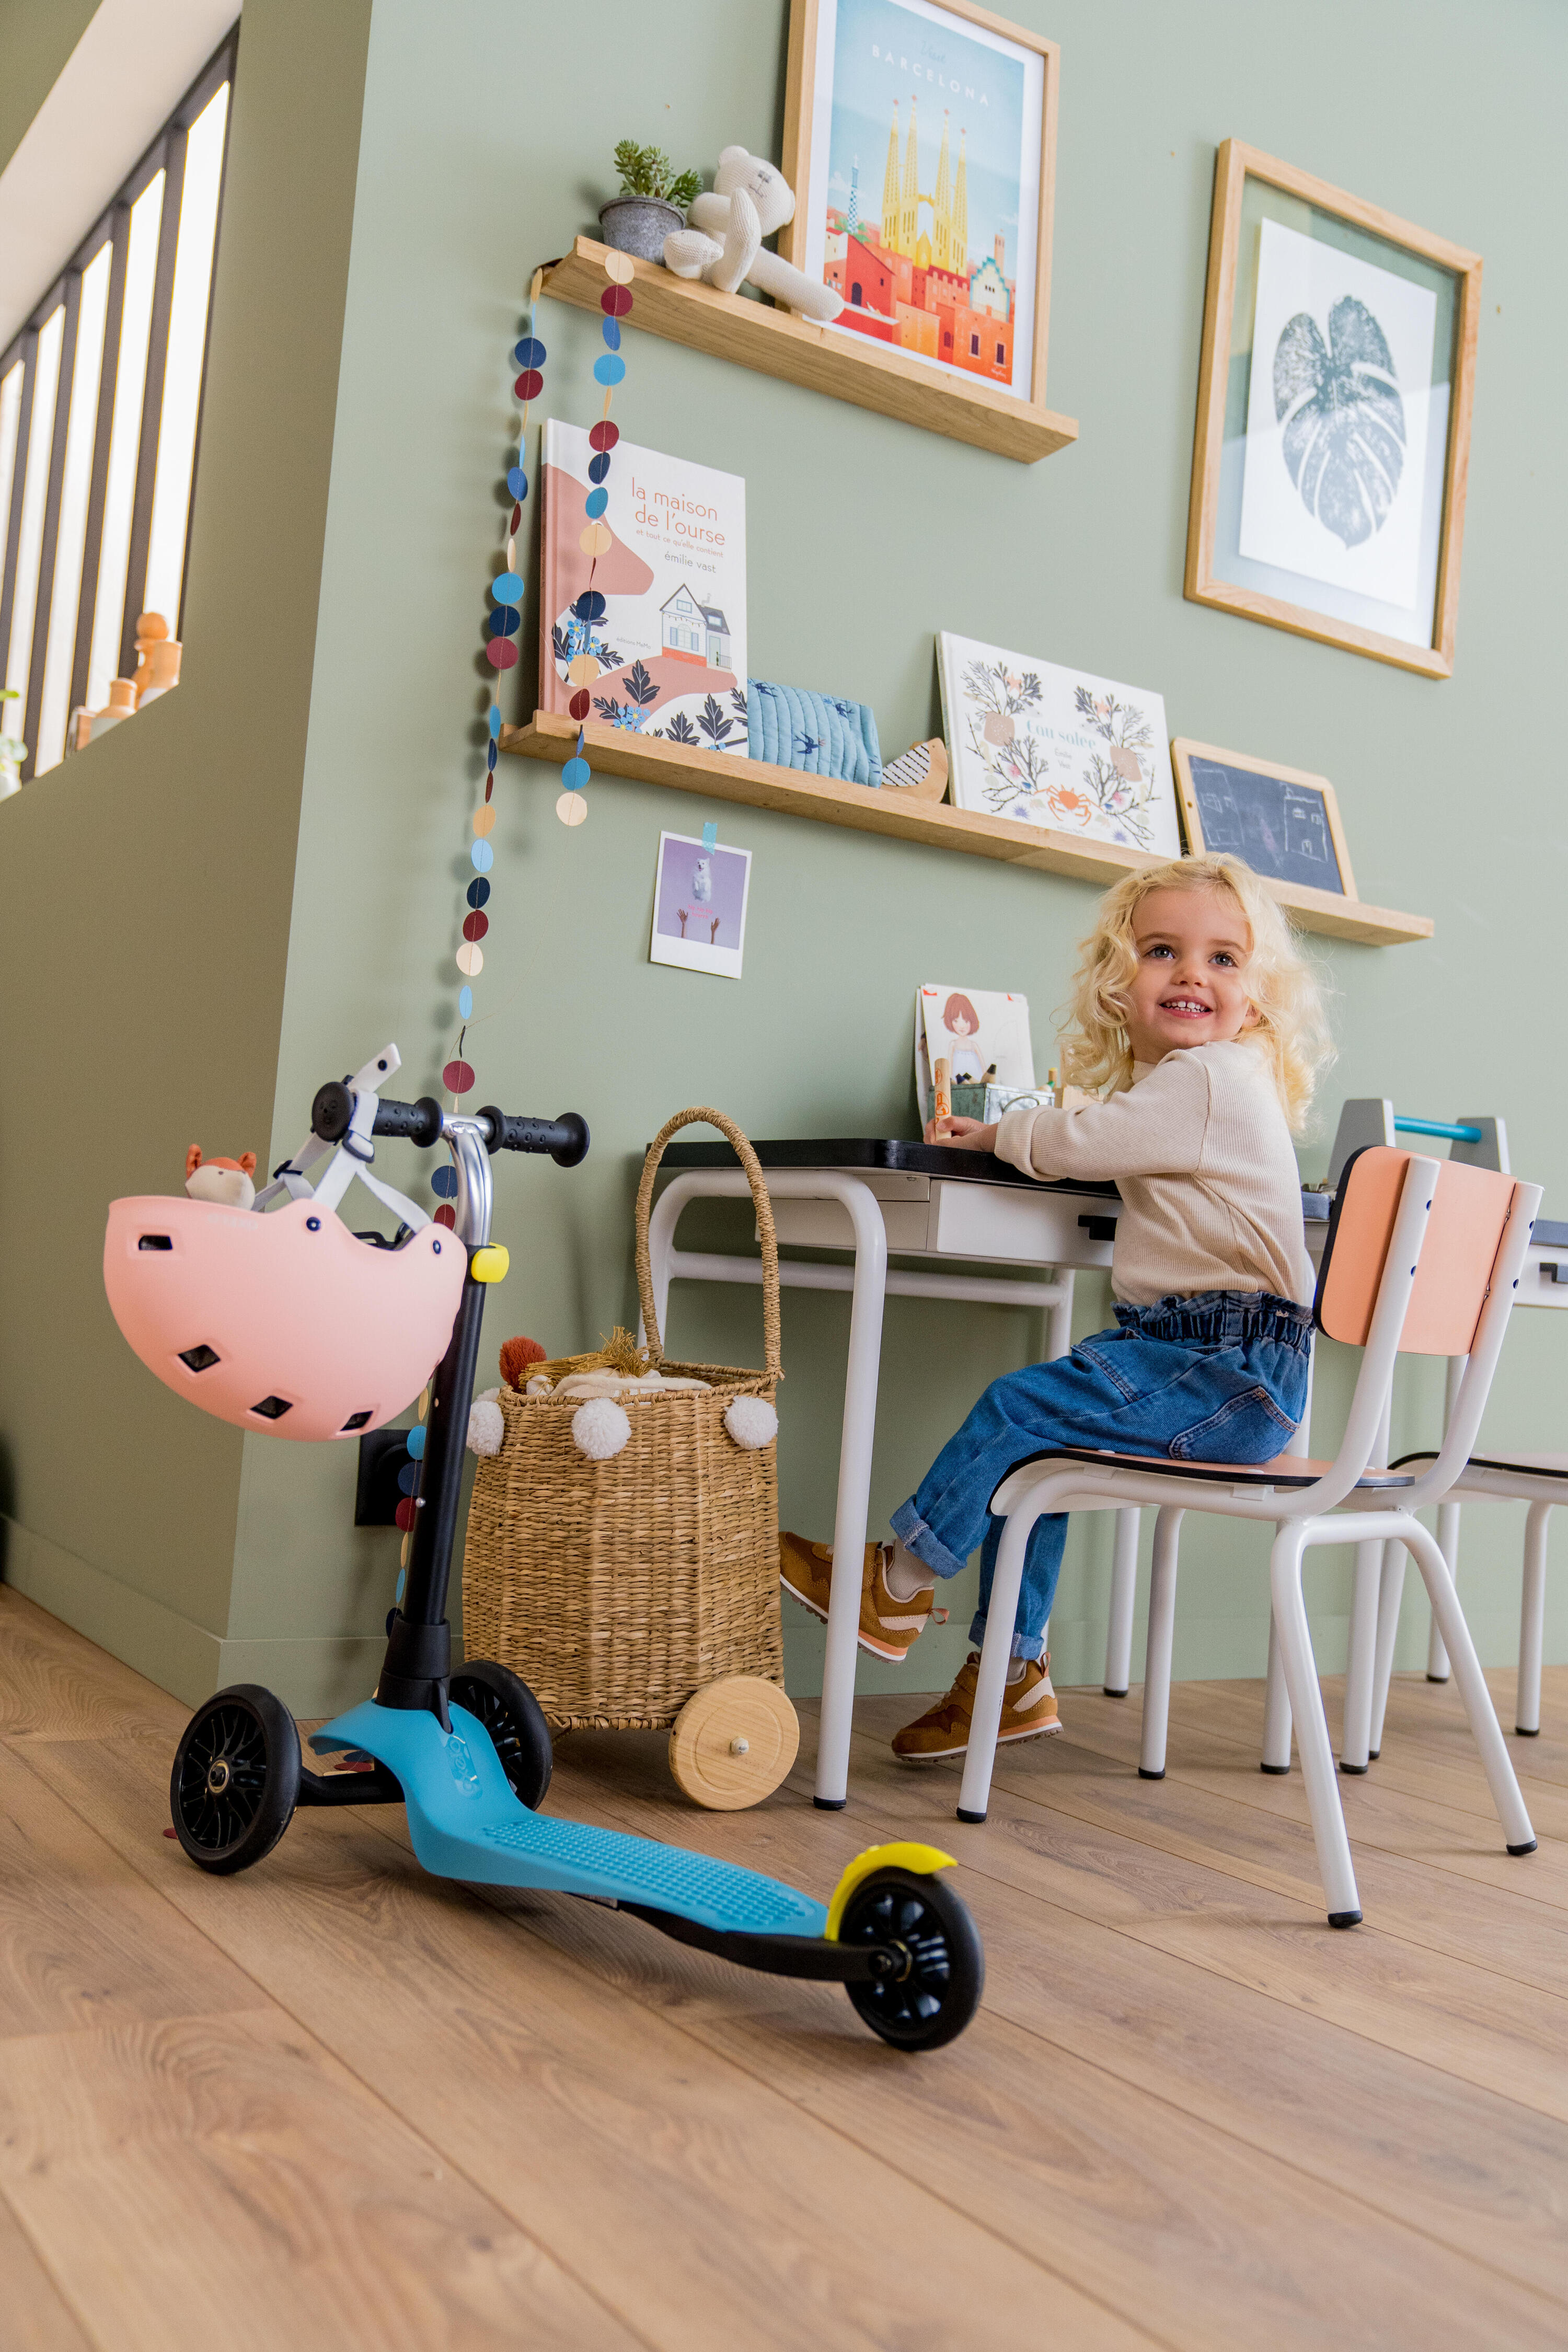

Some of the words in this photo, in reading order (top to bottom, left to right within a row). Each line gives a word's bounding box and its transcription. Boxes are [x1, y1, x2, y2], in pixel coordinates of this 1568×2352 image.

[872, 44, 988, 107] BARCELONA
[632, 477, 645, 500] la
[654, 492, 717, 521] maison
[635, 504, 658, 526] de
[666, 510, 725, 545] l'ourse
[646, 531, 660, 540] tout
[673, 539, 694, 549] qu'elle
[696, 546, 724, 558] contient
[665, 551, 693, 567] émilie
[697, 562, 716, 573] vast
